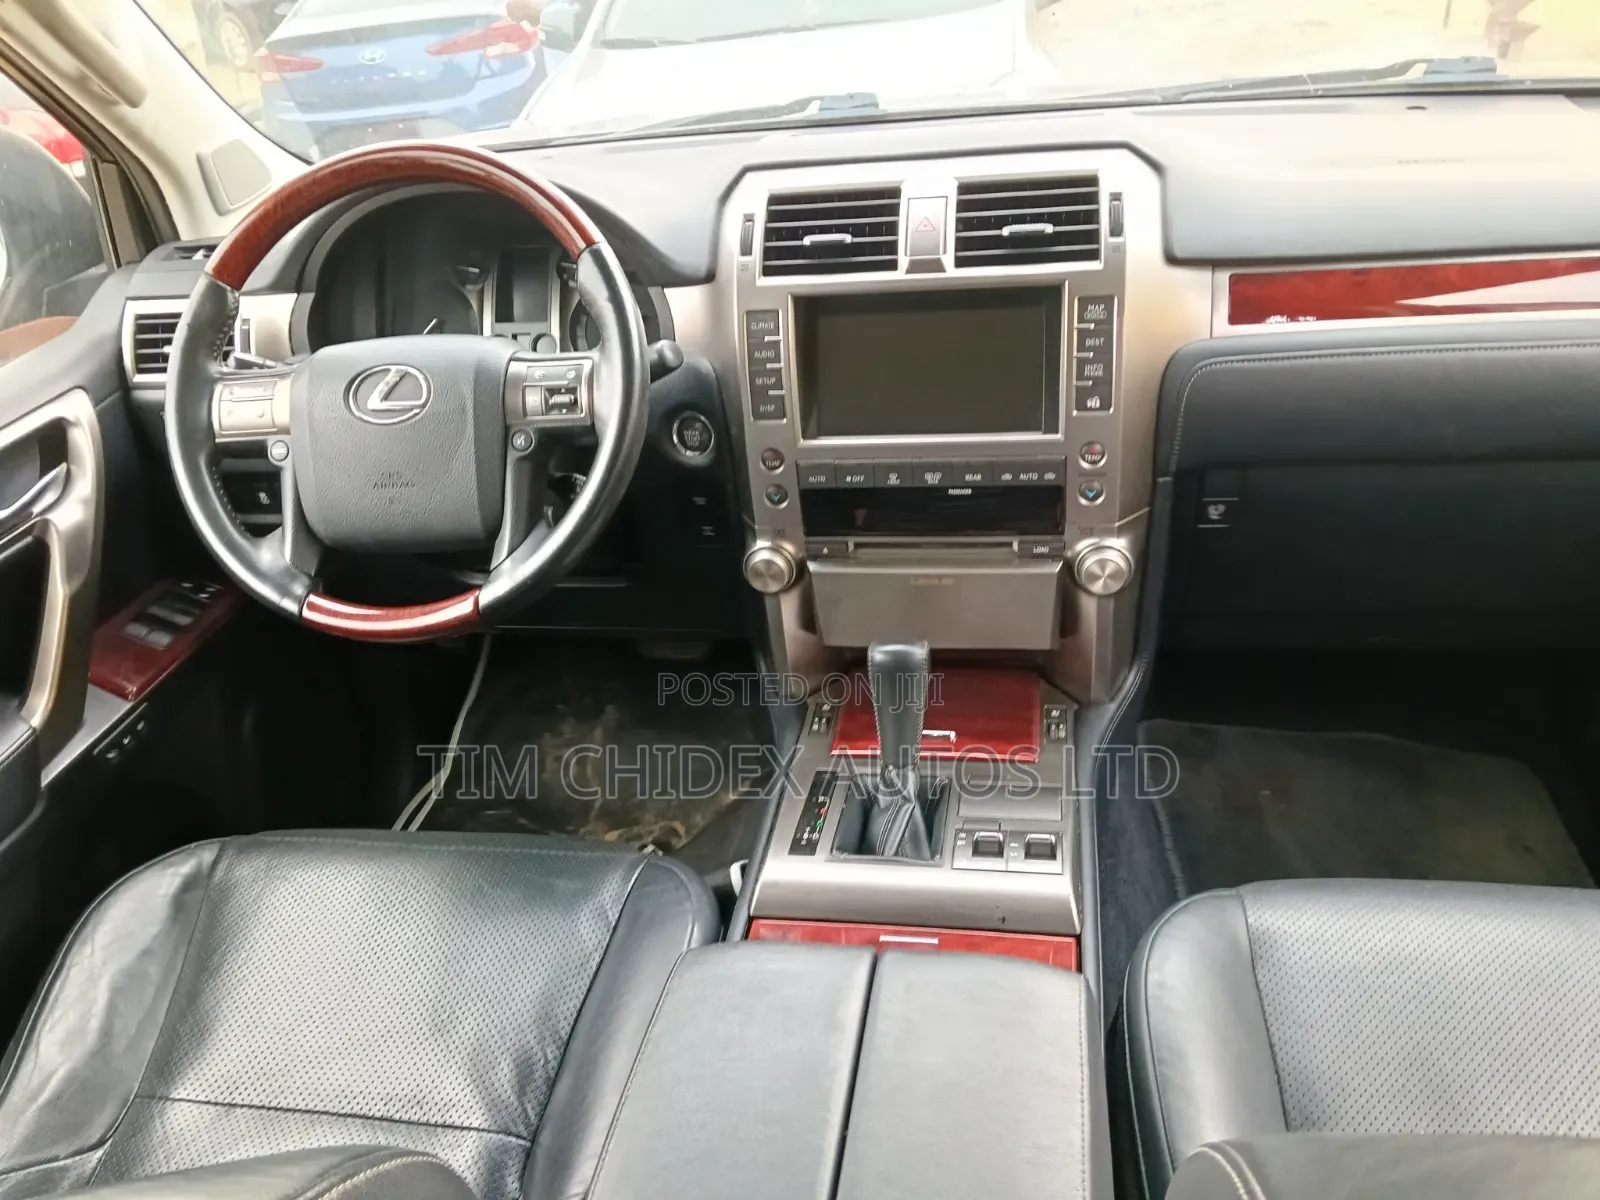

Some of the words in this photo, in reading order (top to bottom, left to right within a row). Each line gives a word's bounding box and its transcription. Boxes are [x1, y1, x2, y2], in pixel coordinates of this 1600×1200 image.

[1087, 304, 1105, 312] MAP
[750, 321, 775, 330] CLIMATE
[1085, 338, 1105, 347] DEST
[754, 350, 775, 359] AUDIO
[755, 377, 776, 385] SETUP
[1085, 454, 1102, 462] TEMP
[808, 475, 826, 483] AUTO
[1019, 473, 1038, 481] AUTO
